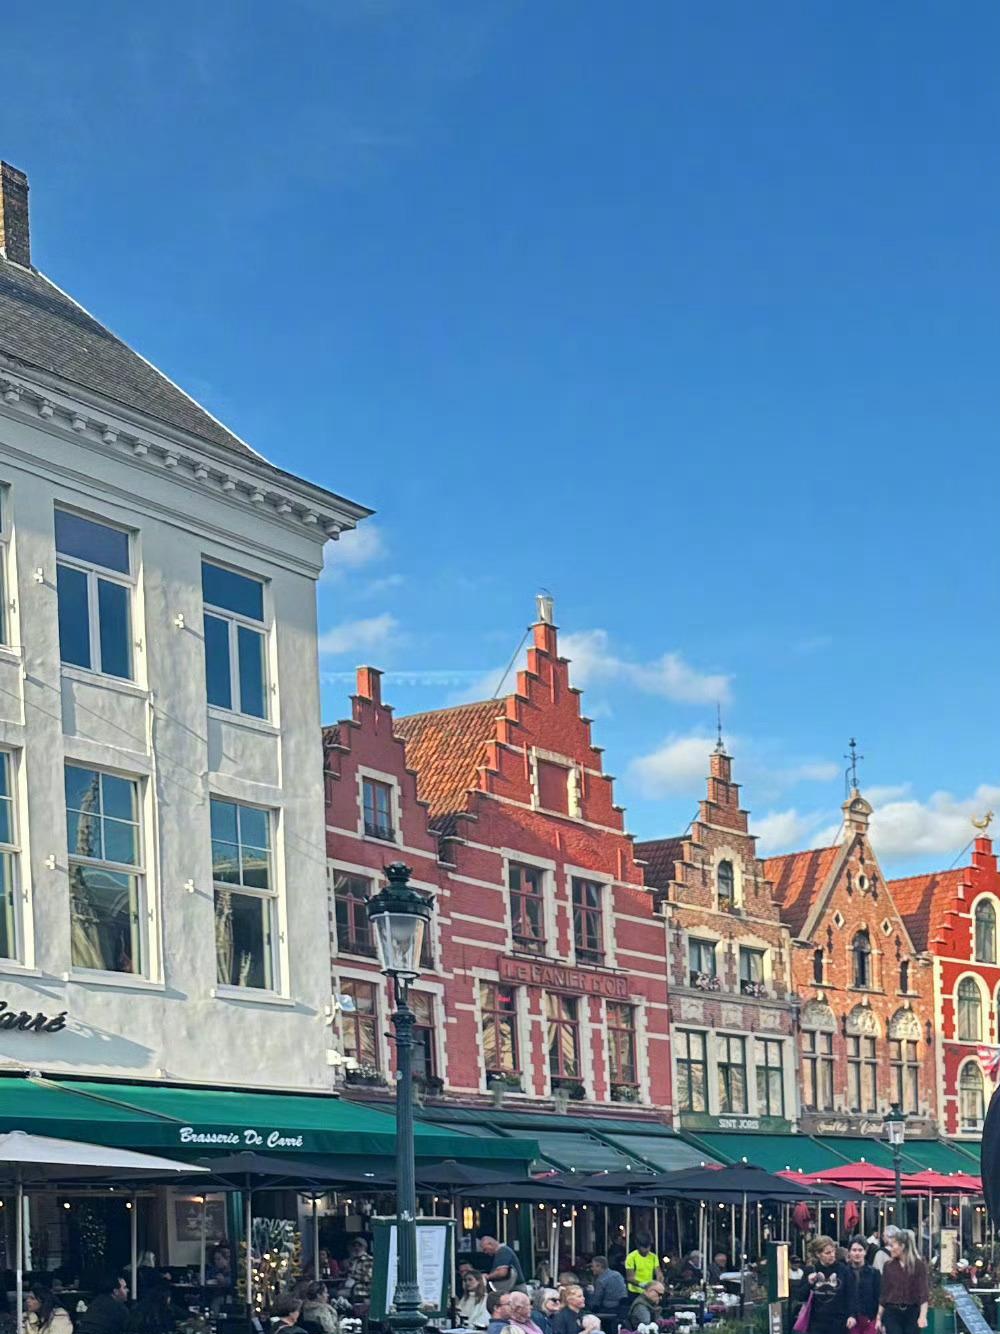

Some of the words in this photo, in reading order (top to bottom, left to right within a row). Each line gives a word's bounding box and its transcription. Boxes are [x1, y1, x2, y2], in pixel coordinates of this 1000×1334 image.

[718, 1118, 737, 1129] SINT
[738, 1119, 760, 1130] JORIS
[179, 1126, 240, 1145] Brasserie
[243, 1128, 264, 1146] De
[266, 1130, 304, 1149] Carré
